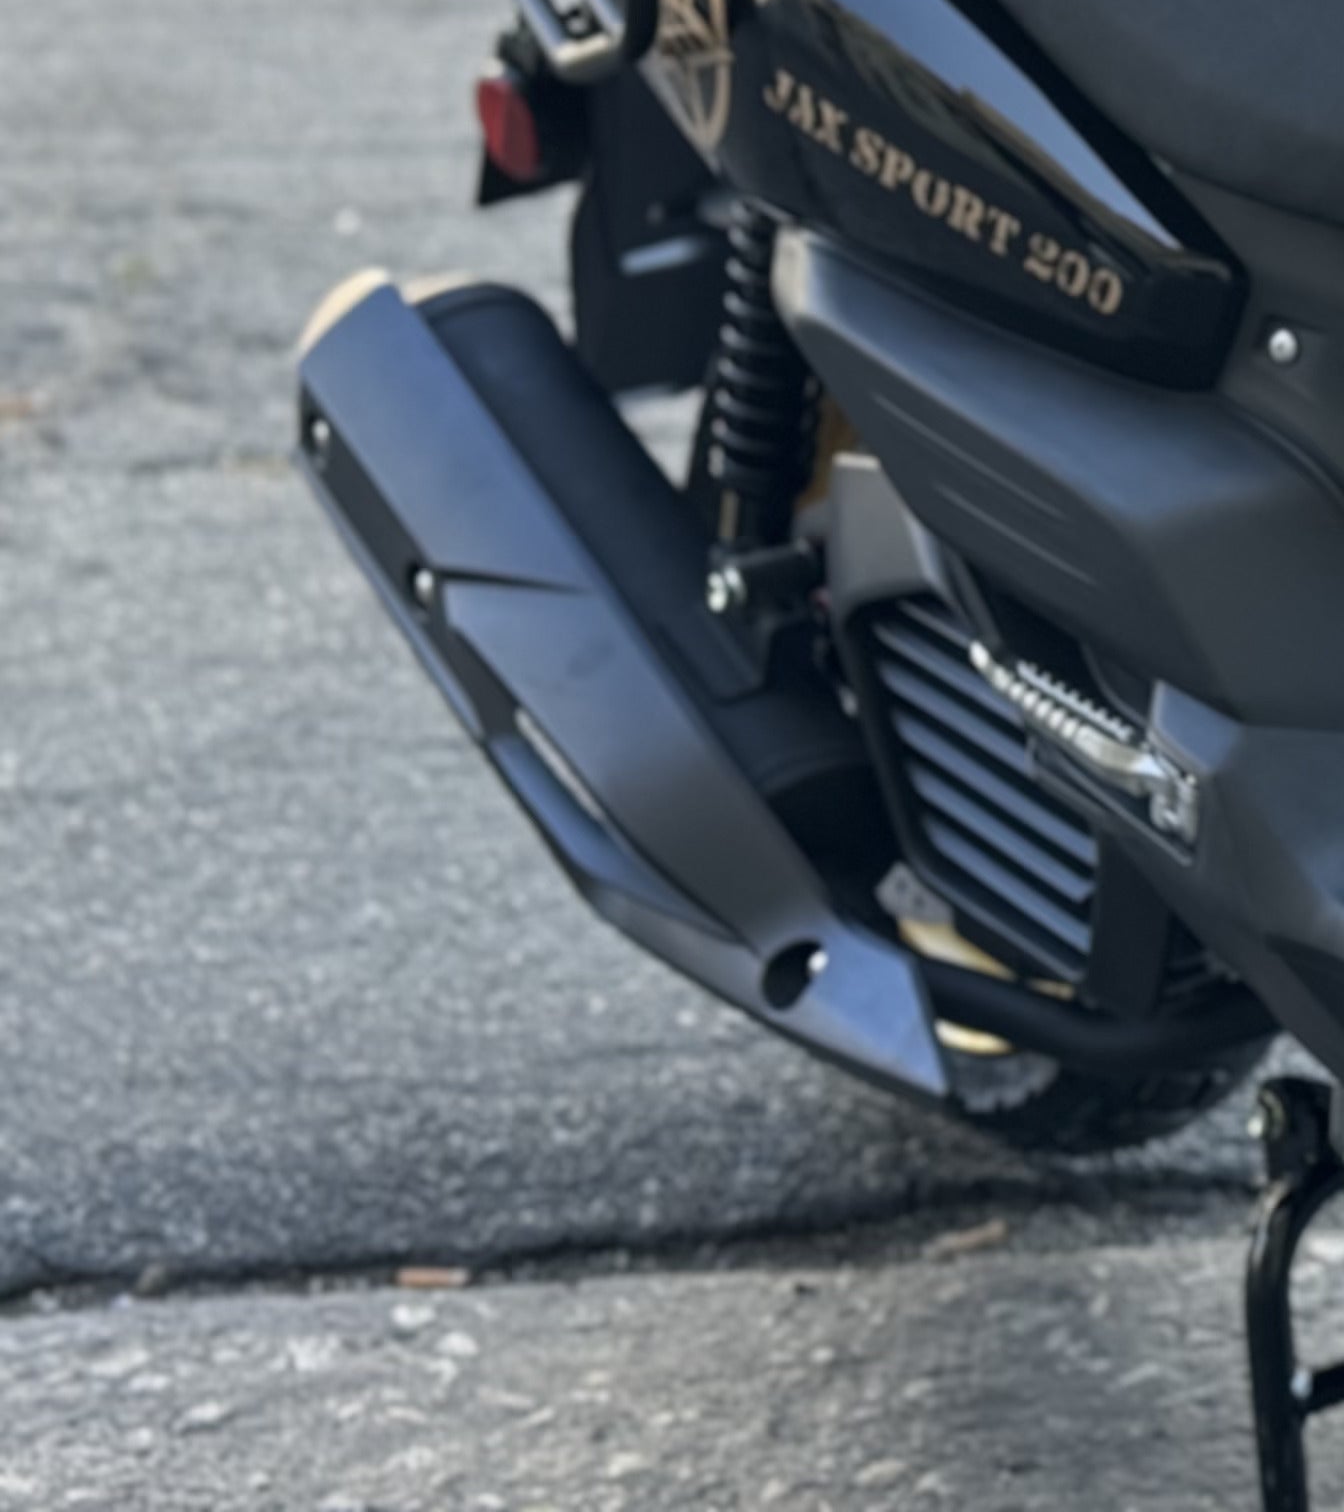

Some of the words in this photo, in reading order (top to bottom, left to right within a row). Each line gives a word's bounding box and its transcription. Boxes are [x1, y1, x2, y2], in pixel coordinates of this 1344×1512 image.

[763, 68, 846, 148] JAX
[849, 126, 1021, 256] SPORT
[1024, 231, 1125, 316] 200
